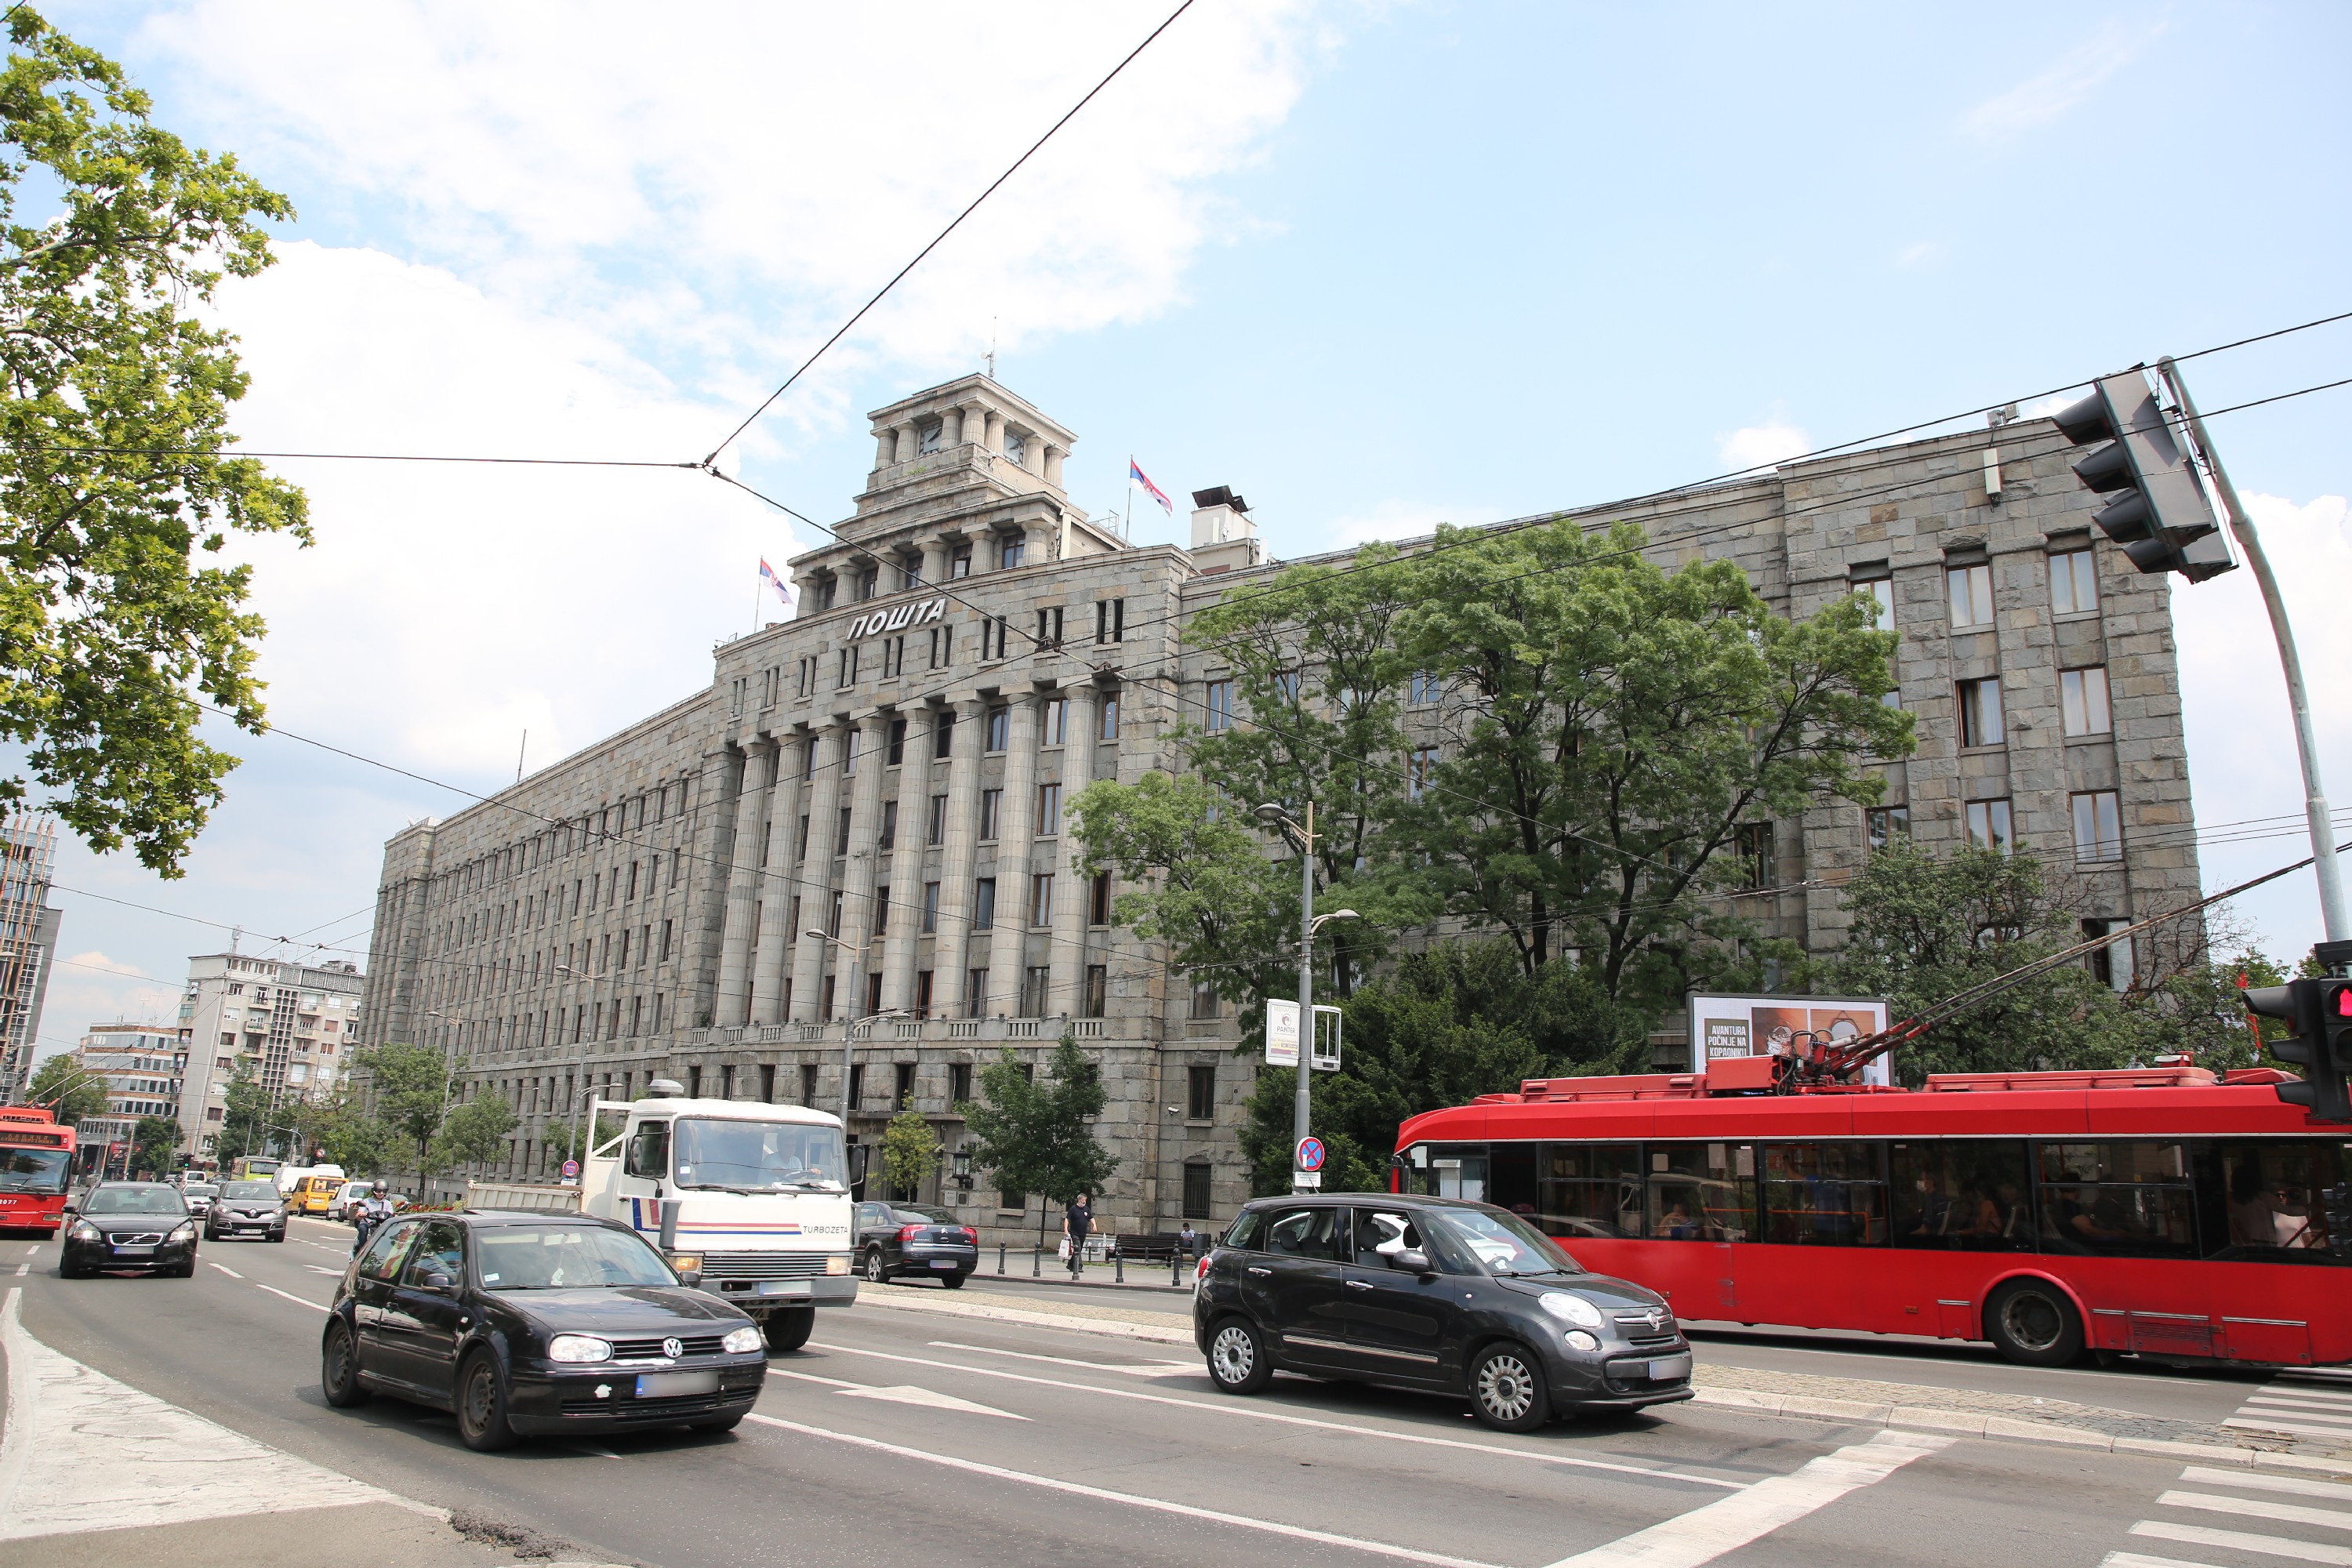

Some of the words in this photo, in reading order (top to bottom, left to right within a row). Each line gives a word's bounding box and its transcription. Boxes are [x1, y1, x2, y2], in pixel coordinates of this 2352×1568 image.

[846, 598, 946, 641] ПОШТА
[1711, 1025, 1746, 1035] AVANTURA
[1708, 1035, 1736, 1046] POČINJE
[1737, 1036, 1747, 1047] NA
[1709, 1047, 1747, 1057] KOPAONIKU
[803, 1225, 848, 1234] TURBOZETA
